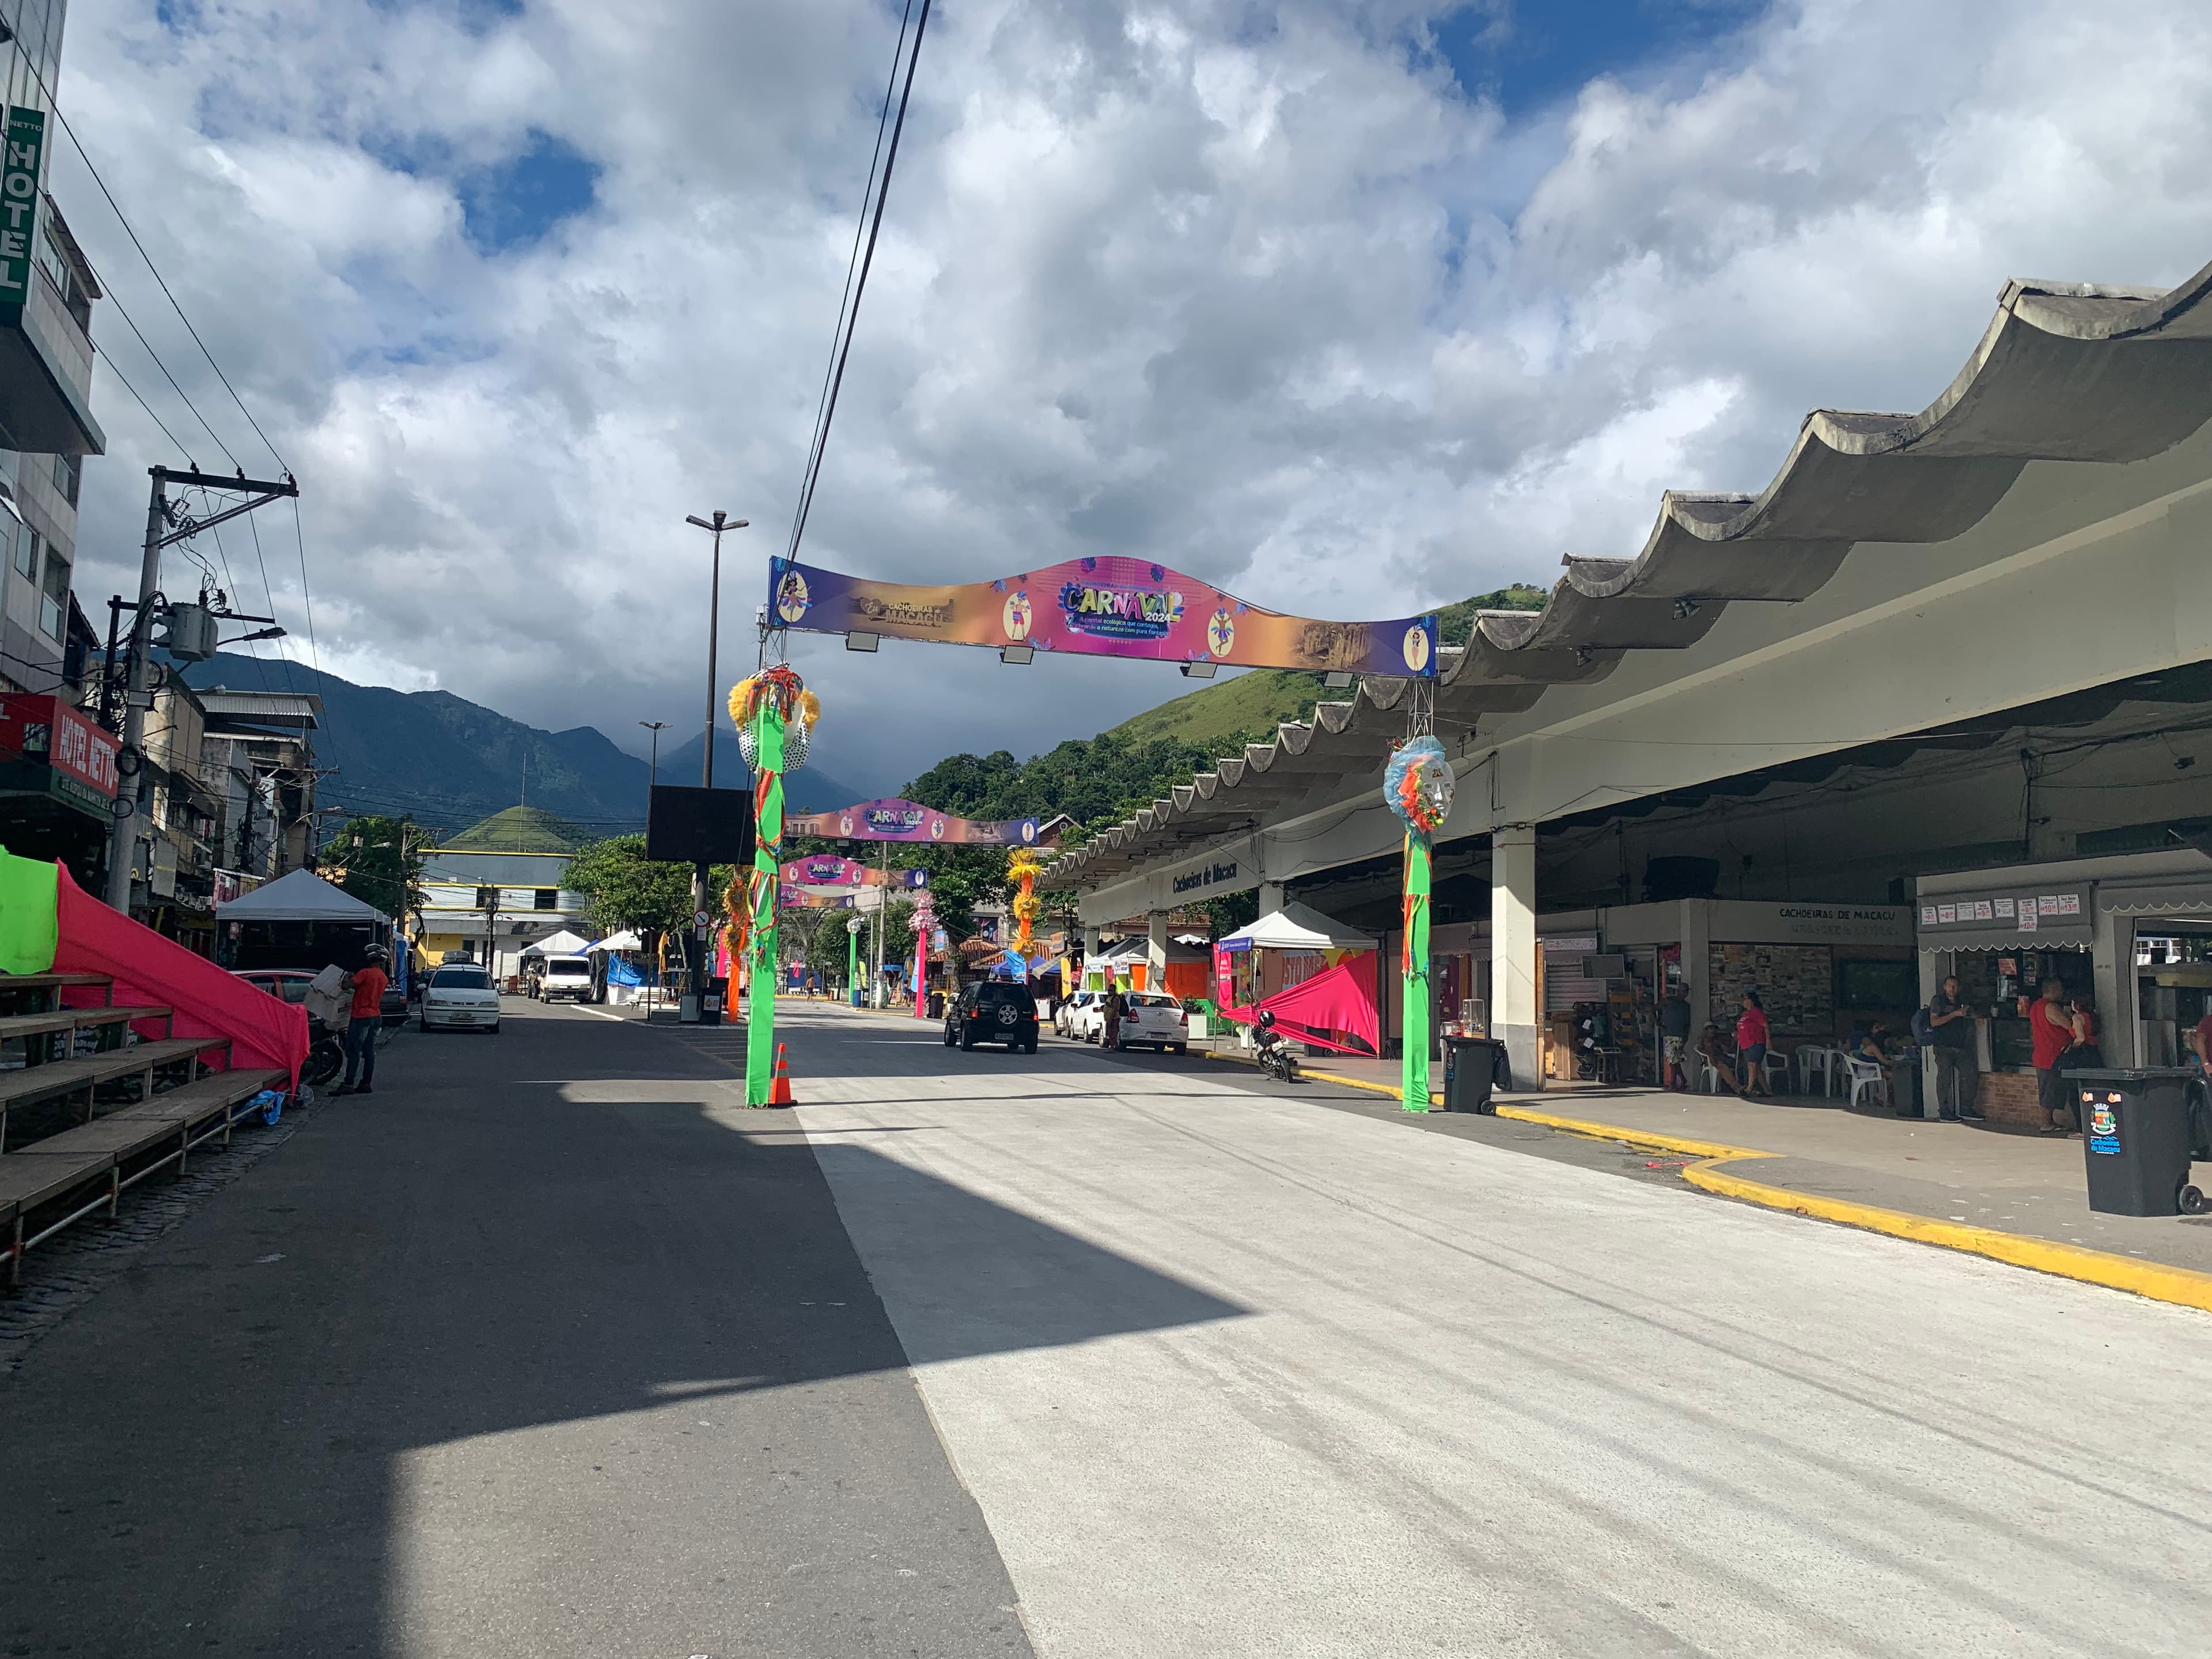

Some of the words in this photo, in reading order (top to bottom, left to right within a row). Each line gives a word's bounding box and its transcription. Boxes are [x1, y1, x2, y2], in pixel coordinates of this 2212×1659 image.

[9, 119, 42, 131] NETTO
[0, 141, 36, 289] HOTEL
[889, 603, 933, 613] CACHOEIRAS
[1064, 586, 1180, 622] CARNAVAL
[1103, 618, 1126, 626] ecológica
[1145, 612, 1171, 622] 2024
[59, 714, 87, 774] HOTEL
[89, 734, 116, 789] NETTO
[867, 810, 924, 824] CARNAVAL
[1173, 872, 1202, 894] Cachoeiras
[1203, 866, 1211, 885] de
[1213, 862, 1237, 883] Macacu
[1779, 908, 1833, 919] CACHOEIRAS
[1838, 911, 1850, 919] DE
[1854, 911, 1895, 921] MACACU
